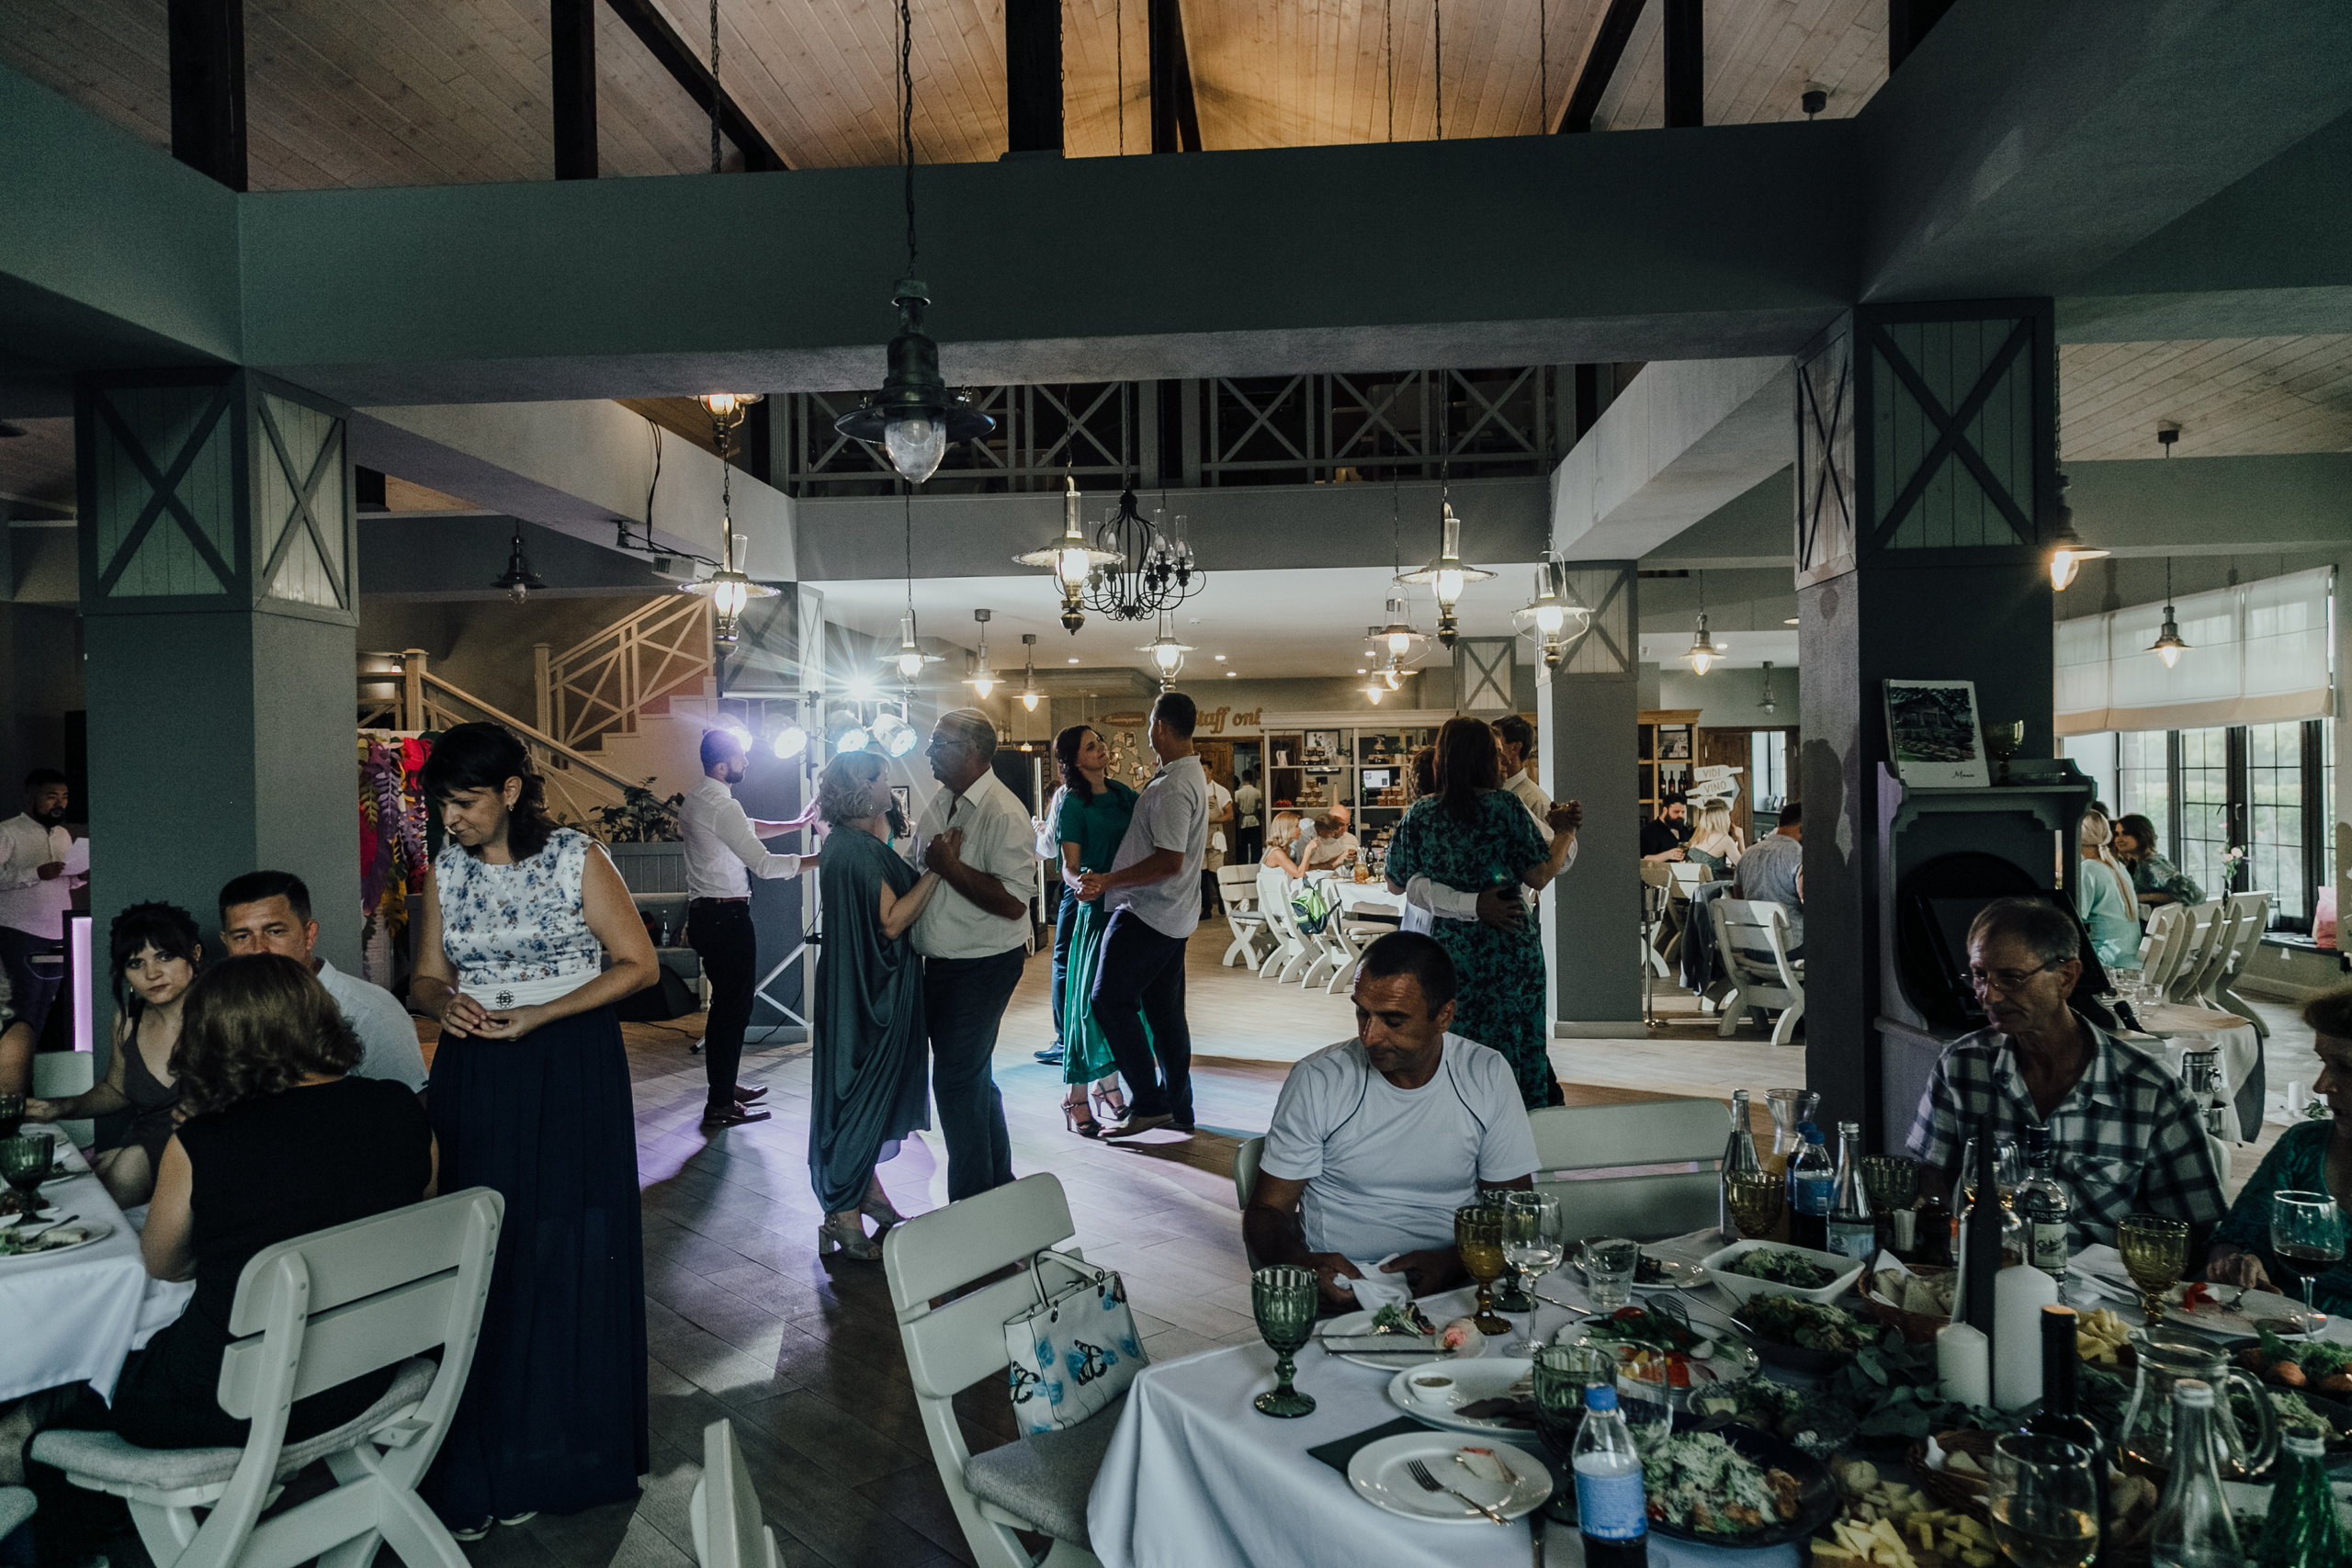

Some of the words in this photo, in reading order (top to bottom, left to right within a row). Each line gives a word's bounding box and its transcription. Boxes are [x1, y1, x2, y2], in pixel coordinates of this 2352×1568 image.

[1195, 706, 1231, 734] taff
[1232, 706, 1265, 734] onl
[1702, 768, 1721, 778] VIDI
[1703, 780, 1727, 794] VINO
